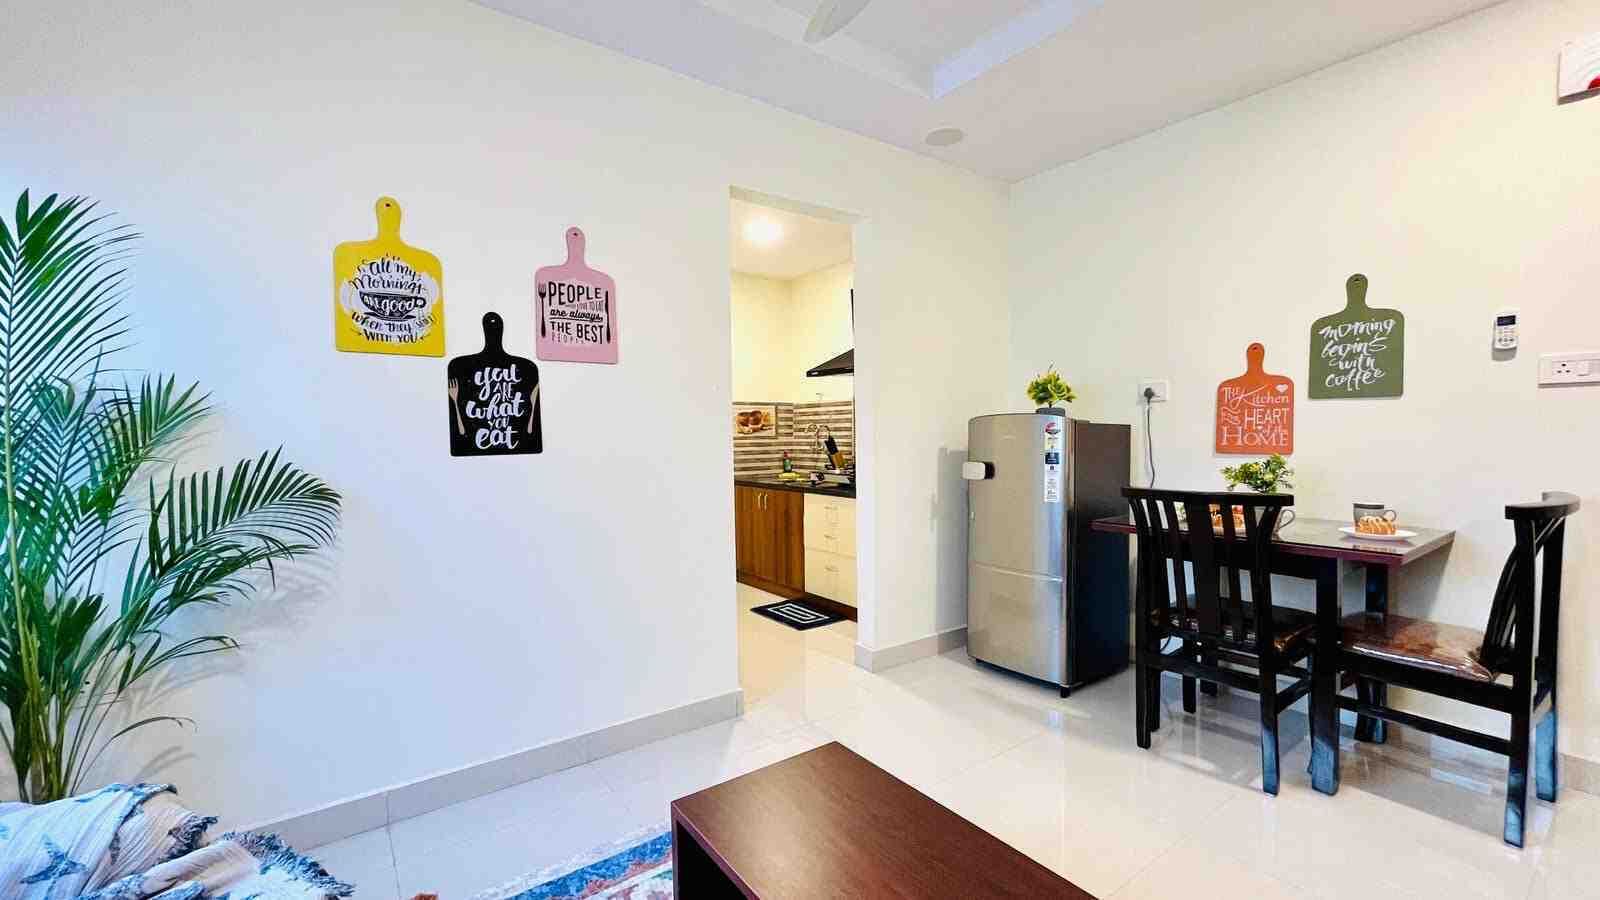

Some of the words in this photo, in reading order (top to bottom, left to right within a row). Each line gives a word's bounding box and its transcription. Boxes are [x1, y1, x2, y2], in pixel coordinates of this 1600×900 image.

[548, 281, 602, 307] PEOPLE
[549, 309, 567, 317] are
[397, 333, 418, 343] YOU
[550, 321, 572, 335] THE
[576, 323, 604, 344] BEST
[474, 363, 522, 400] you
[465, 391, 525, 420] what
[1244, 407, 1290, 430] HEART
[475, 425, 519, 449] eat
[1221, 426, 1289, 447] HOME
